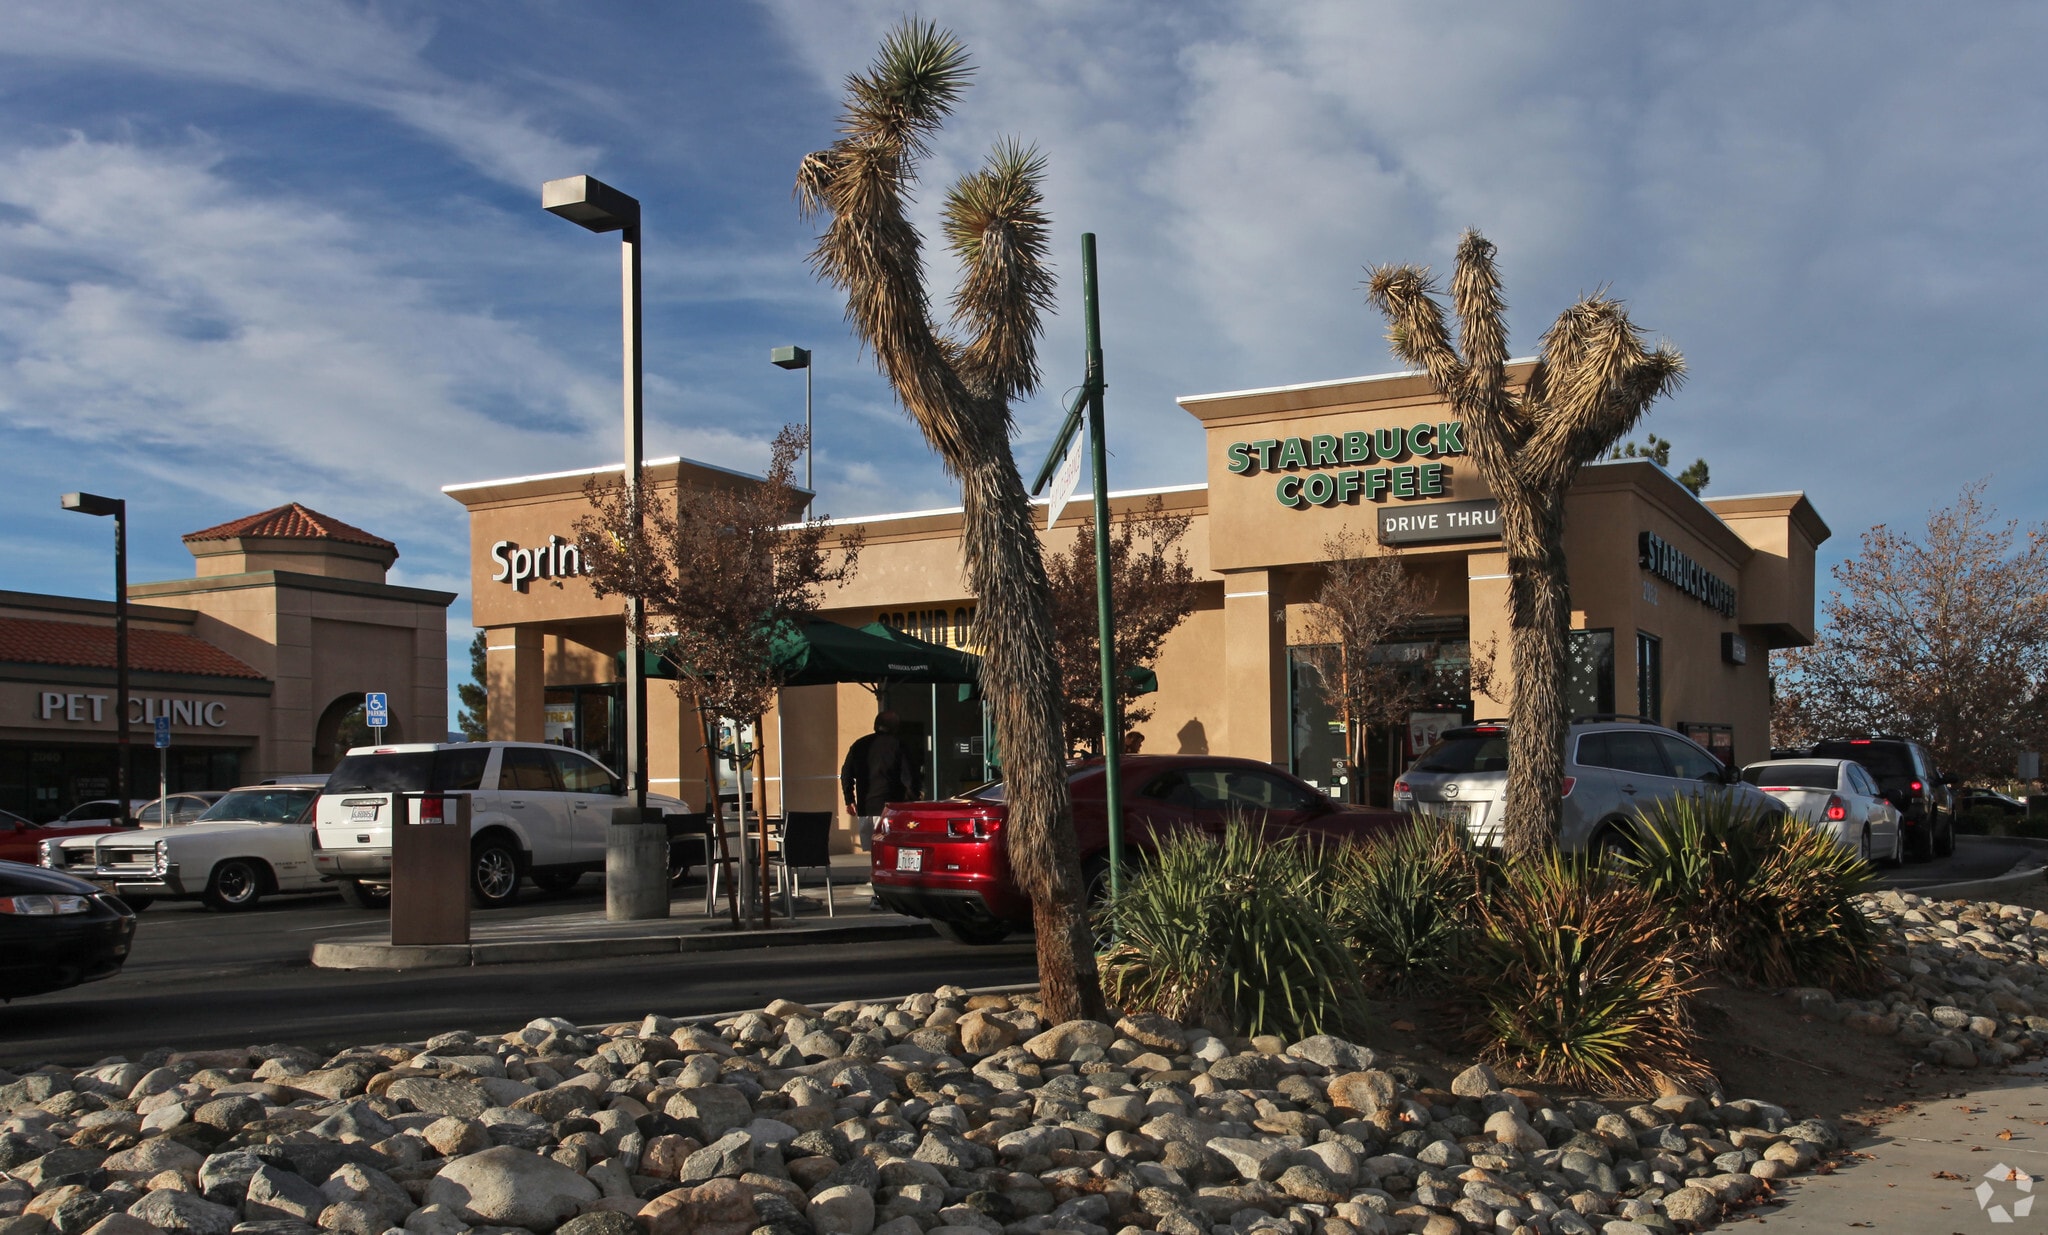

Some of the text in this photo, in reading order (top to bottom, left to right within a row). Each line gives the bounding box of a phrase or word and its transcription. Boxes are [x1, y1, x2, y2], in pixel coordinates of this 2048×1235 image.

[1226, 421, 1464, 474] STARBUCK
[1275, 462, 1442, 507] COFFEE
[1386, 509, 1496, 532] DRIVE THRU
[1648, 530, 1707, 602] STARBUCKS
[41, 692, 227, 727] PET CLINIC
